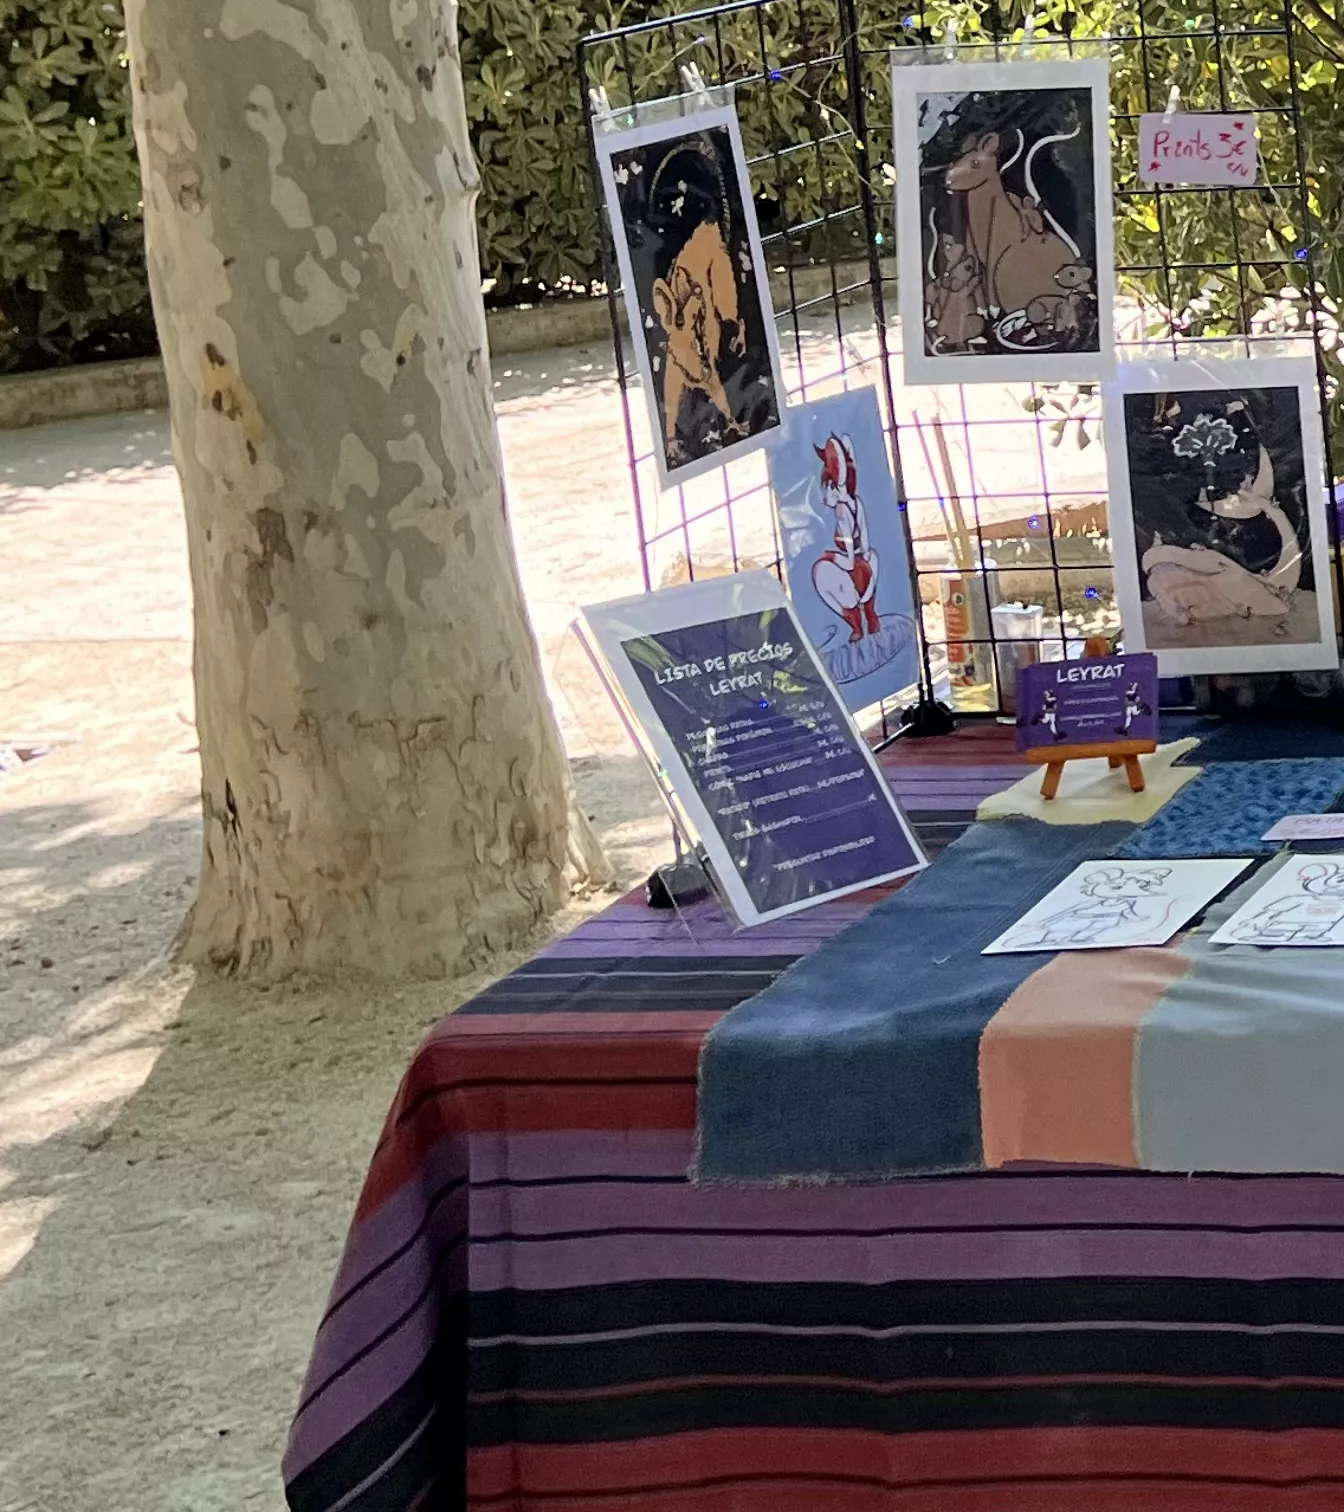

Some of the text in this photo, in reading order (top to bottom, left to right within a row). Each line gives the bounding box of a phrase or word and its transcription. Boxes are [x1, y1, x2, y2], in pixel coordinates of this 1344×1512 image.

[1153, 128, 1213, 160] Prints
[654, 641, 794, 685] LISTA DE PRECIOS
[1056, 663, 1125, 684] LEYRAT
[709, 671, 764, 696] LEYRAT
